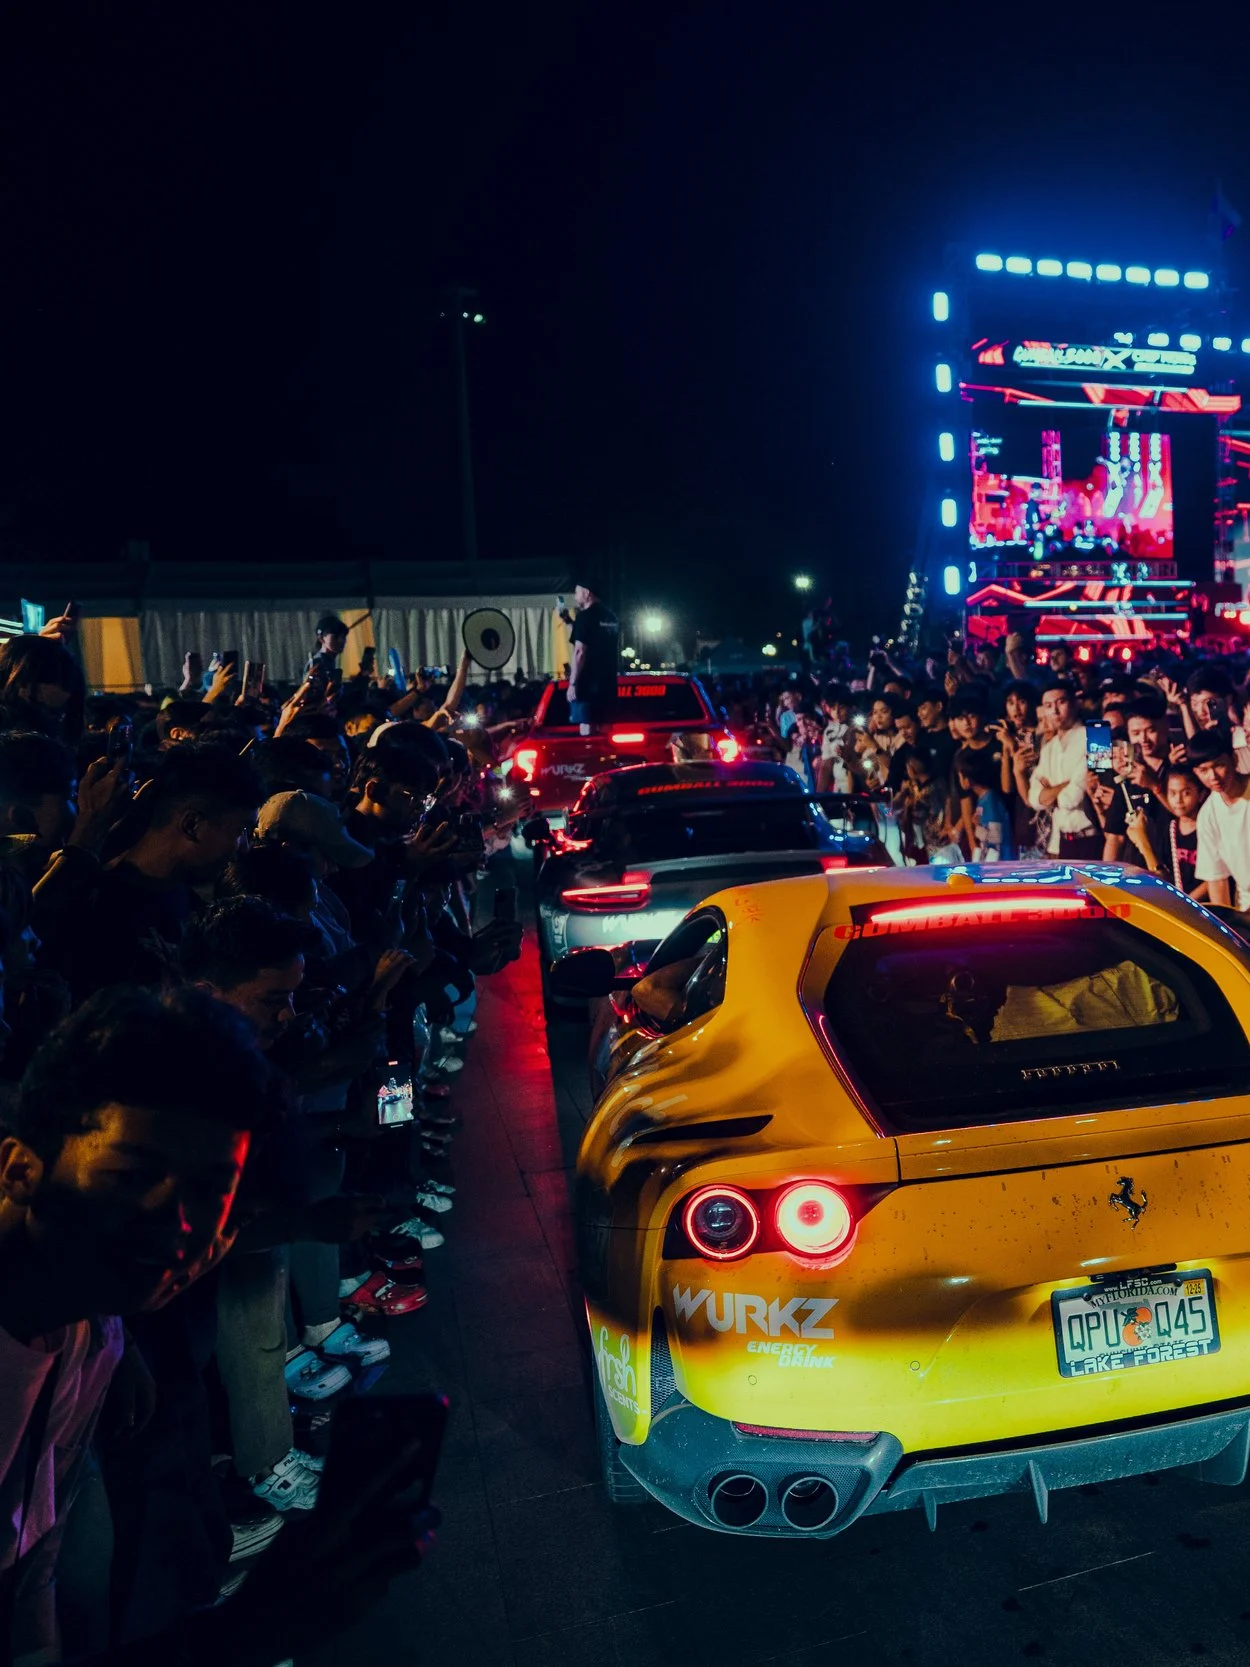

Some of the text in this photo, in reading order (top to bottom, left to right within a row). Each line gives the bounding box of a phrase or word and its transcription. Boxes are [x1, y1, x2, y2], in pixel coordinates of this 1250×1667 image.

[833, 903, 1131, 940] GUMBALL 3000
[1090, 1286, 1178, 1309] MYFLORIDA.COM
[1104, 1277, 1163, 1292] www.LFSC.com
[1185, 1283, 1202, 1295] 12-25
[673, 1283, 840, 1339] WURKZ
[1067, 1295, 1207, 1351] QPU Q45
[747, 1341, 818, 1357] ENERGY
[778, 1355, 837, 1368] DRINK
[1070, 1338, 1211, 1376] LAKE FOREST
[608, 1385, 641, 1415] SCENTS
